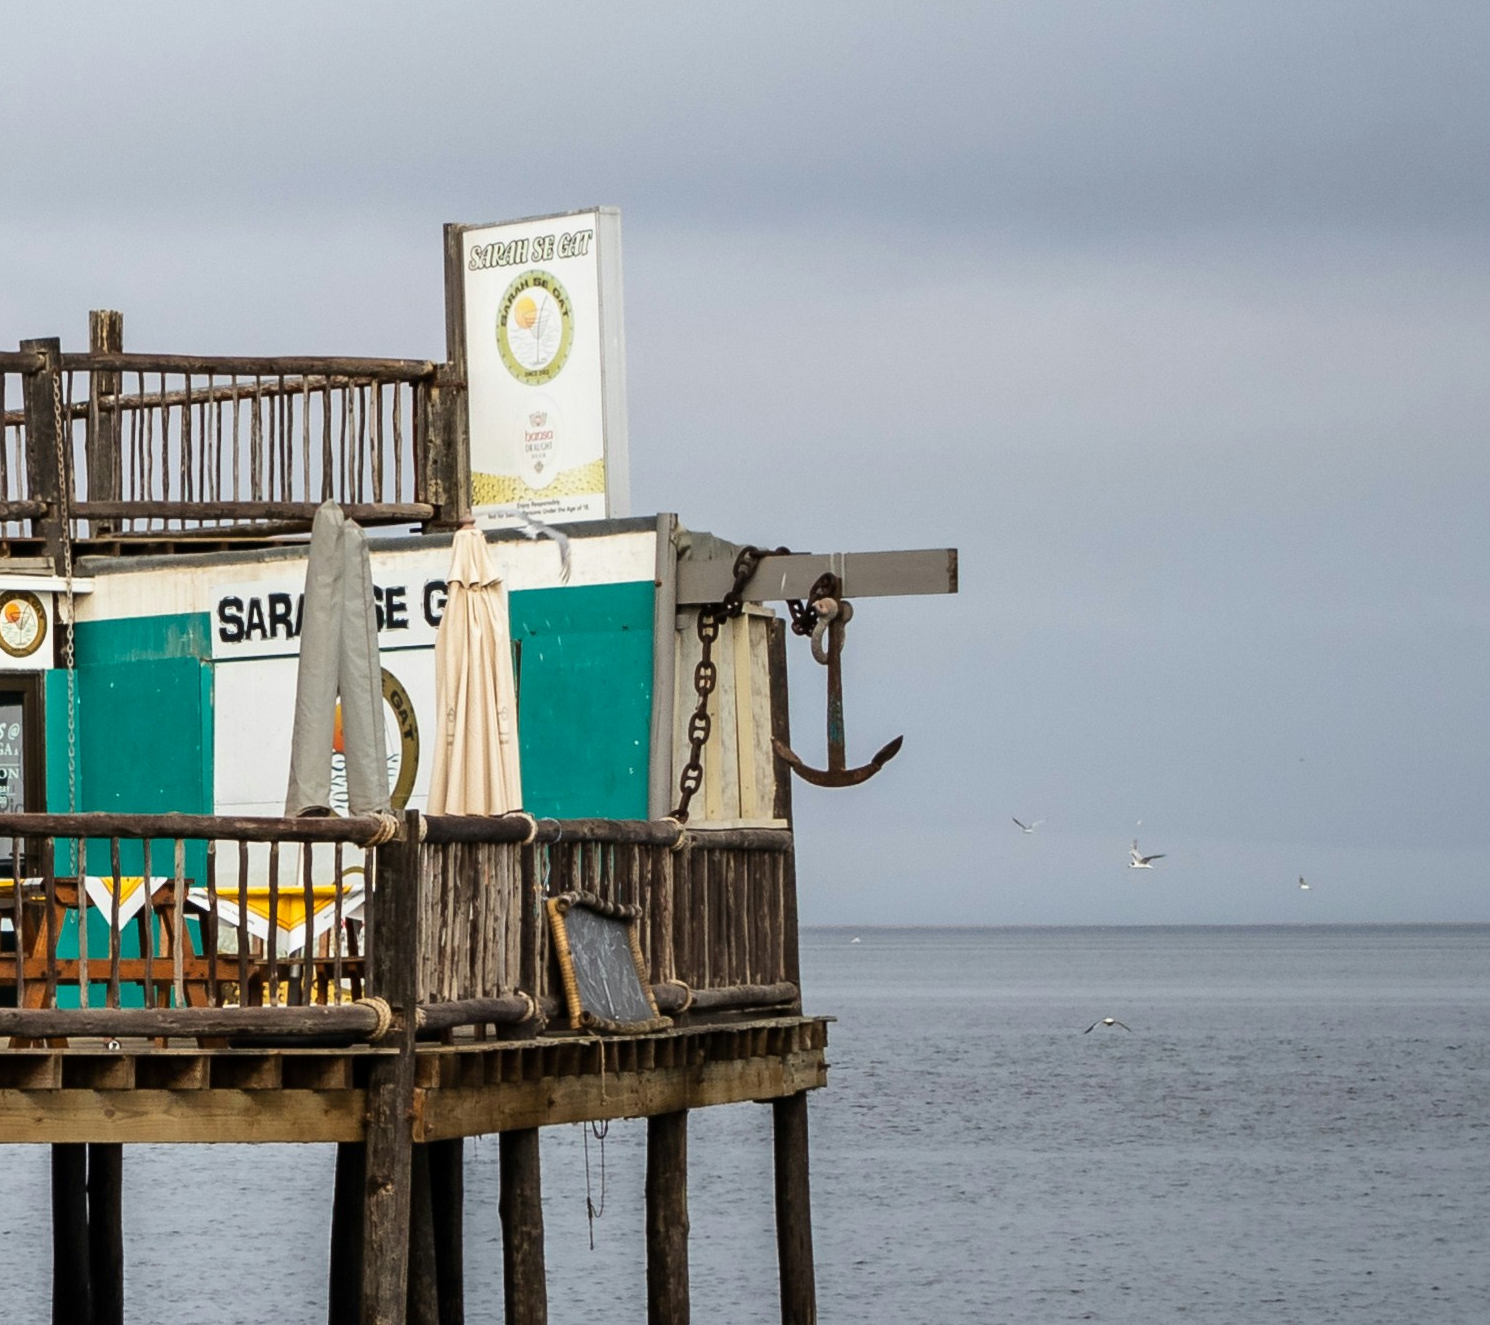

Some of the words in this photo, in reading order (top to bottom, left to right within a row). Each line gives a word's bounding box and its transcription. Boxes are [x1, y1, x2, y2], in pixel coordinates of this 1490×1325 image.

[468, 238, 529, 271] SARAH
[531, 234, 555, 262] SE
[557, 229, 593, 259] GAT
[500, 278, 530, 327] SARAH
[532, 277, 549, 287] SE
[552, 287, 570, 318] GAT
[217, 591, 305, 644] SAR
[7, 723, 21, 740] @
[389, 690, 416, 743] GAT
